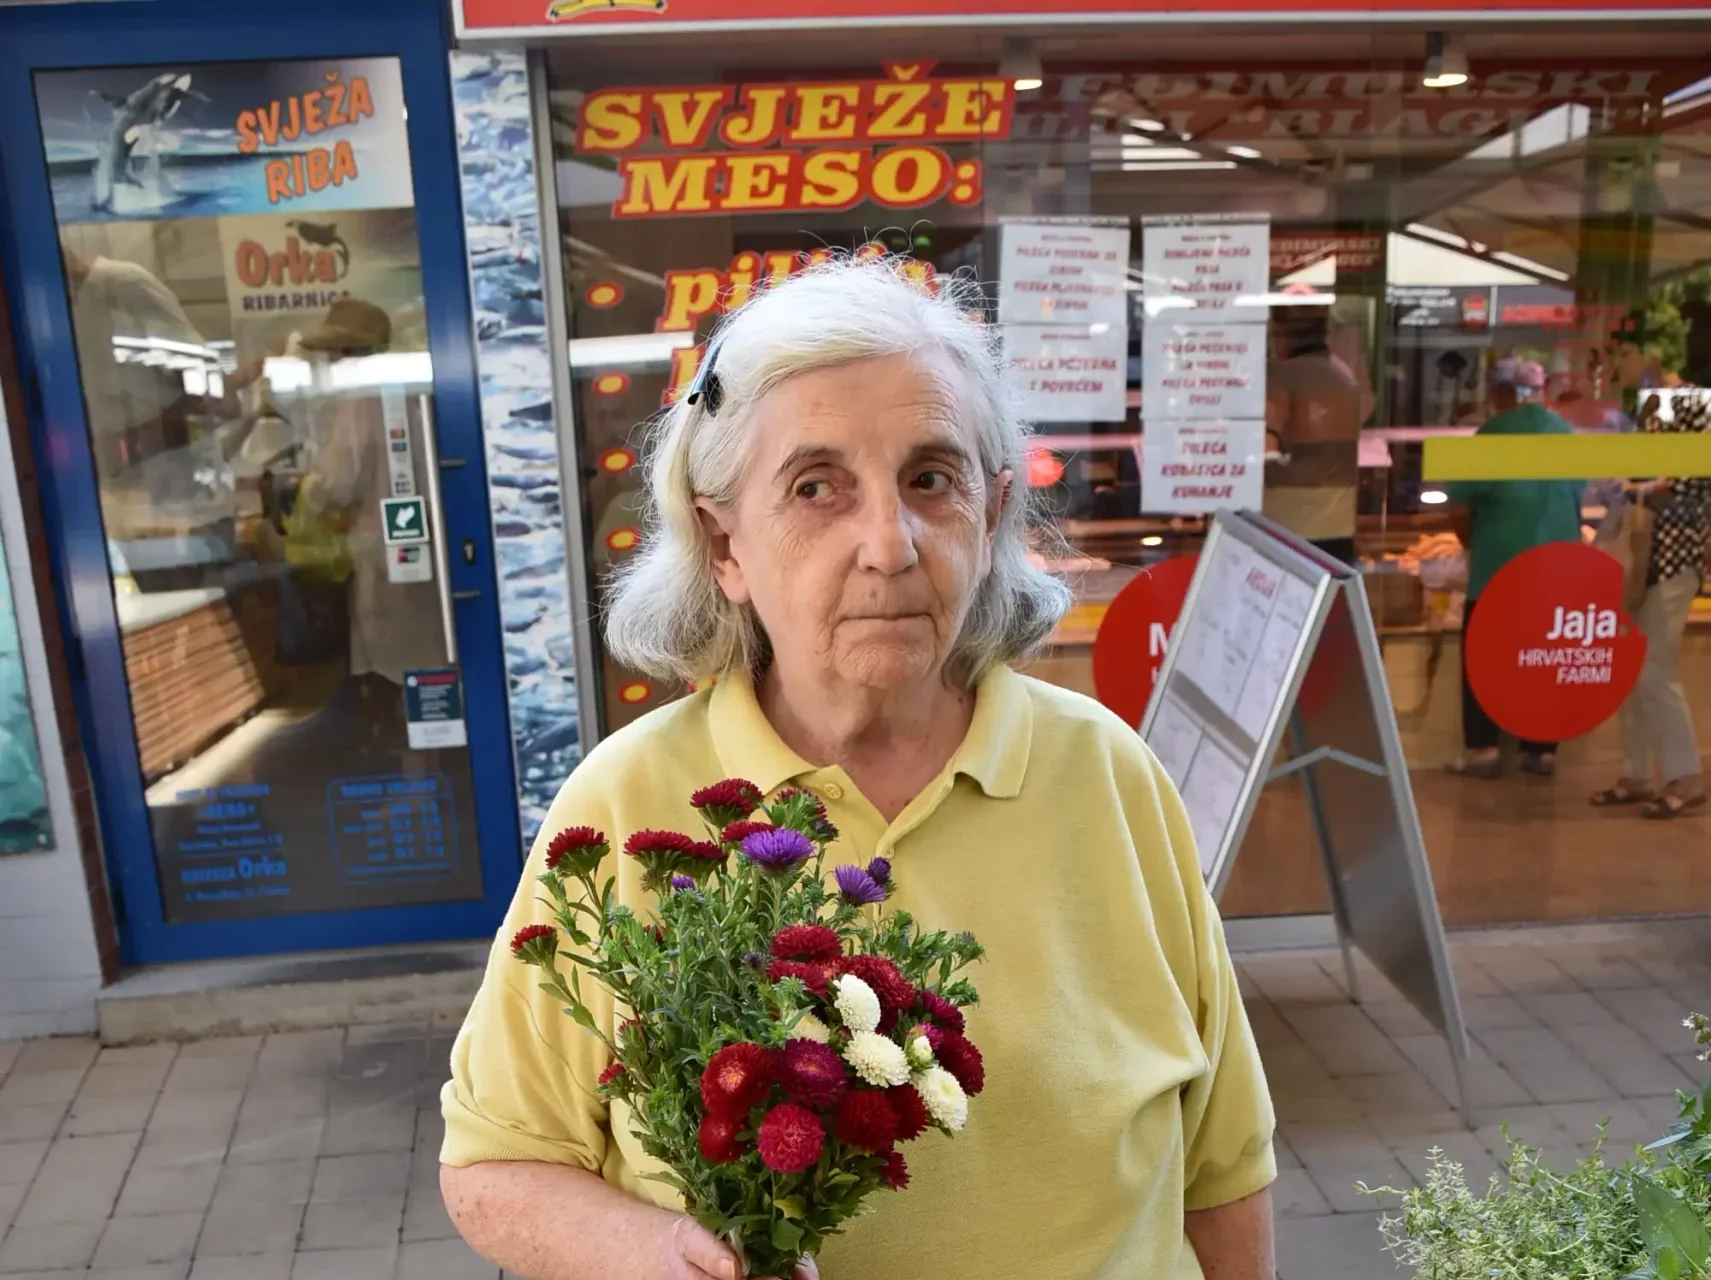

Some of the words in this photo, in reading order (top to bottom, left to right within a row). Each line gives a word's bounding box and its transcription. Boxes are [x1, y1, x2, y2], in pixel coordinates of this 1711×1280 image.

[237, 71, 374, 153] SVJEŽA
[581, 63, 1008, 151] SVJEŽE
[265, 140, 358, 205] RIBA
[620, 147, 975, 214] MESO:
[236, 236, 337, 288] Orka
[1546, 603, 1618, 646] Jaja
[1518, 648, 1614, 667] HRVATSKIH
[1556, 666, 1612, 685] FARMI
